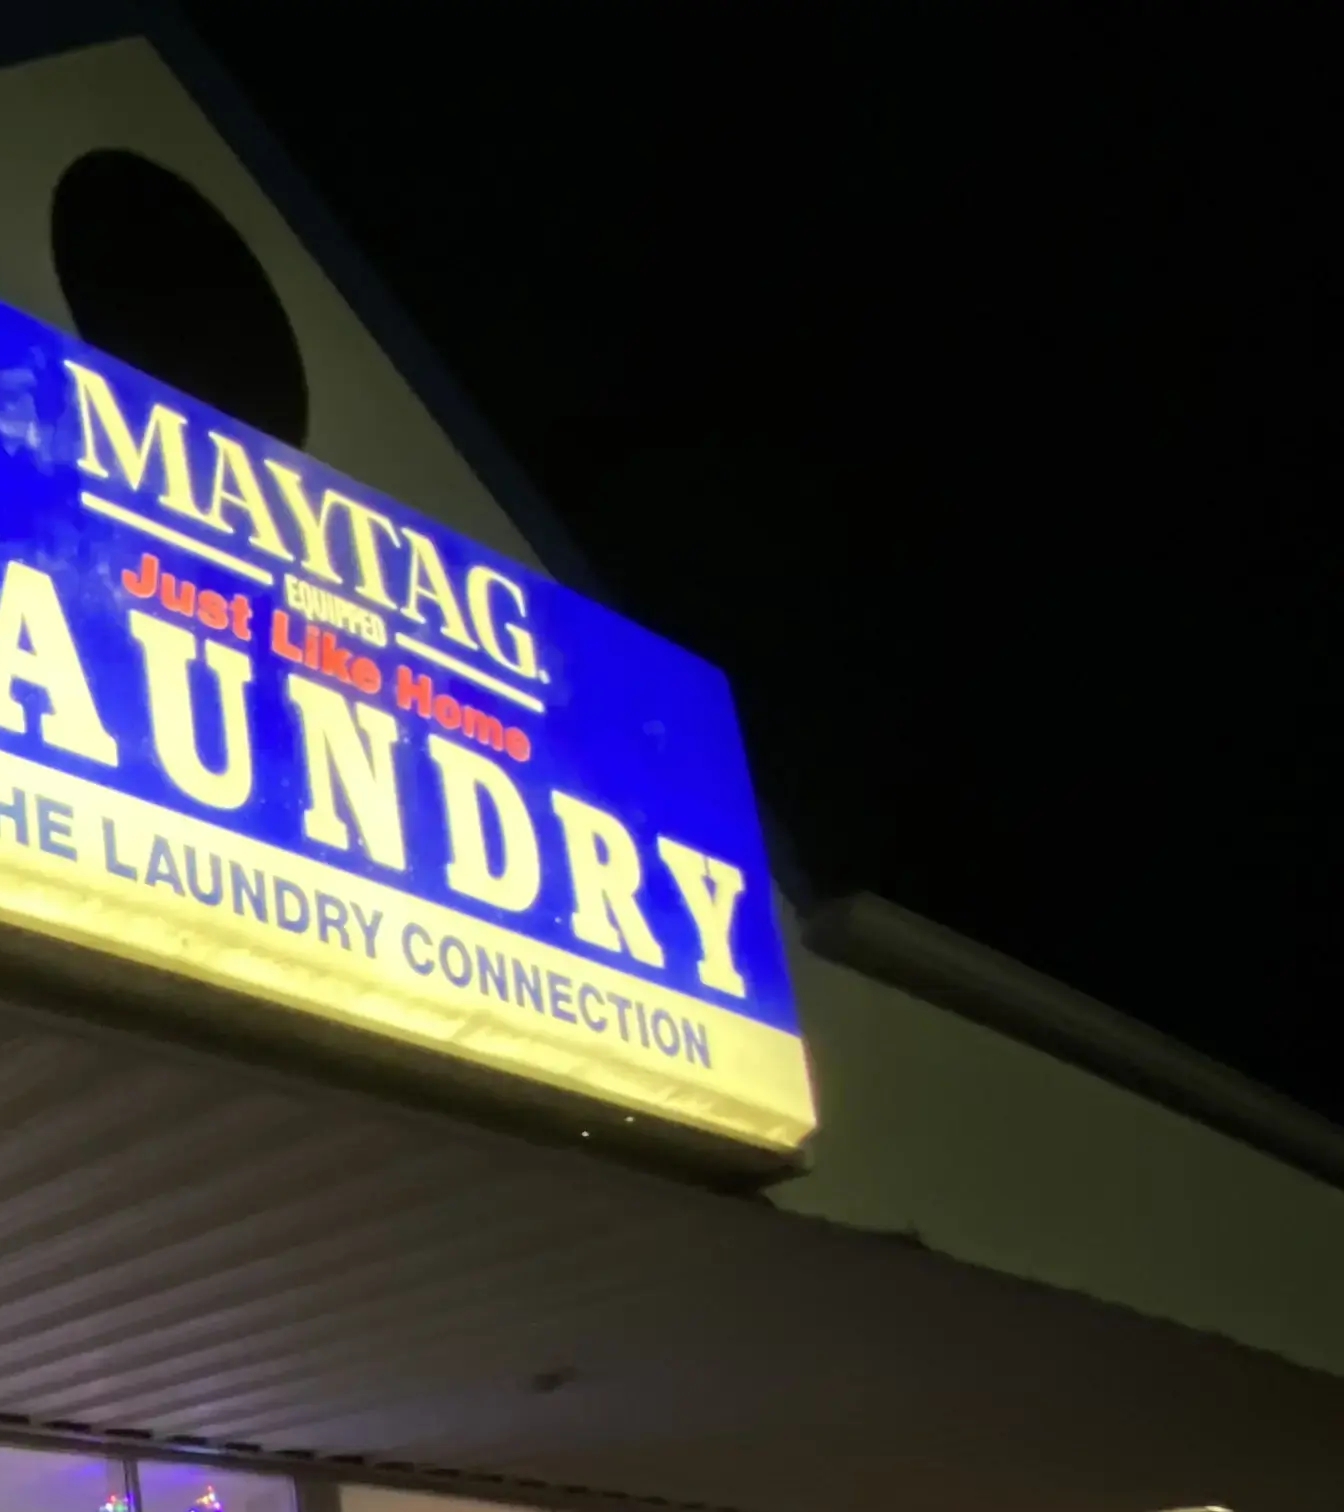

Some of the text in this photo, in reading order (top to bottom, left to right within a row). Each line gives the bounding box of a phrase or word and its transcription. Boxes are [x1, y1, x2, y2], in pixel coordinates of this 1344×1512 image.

[121, 552, 532, 762] Just Like Home
[283, 573, 387, 648] EQUIPPED
[101, 812, 387, 962] LAUNDRY
[402, 920, 714, 1070] CONNECTION
